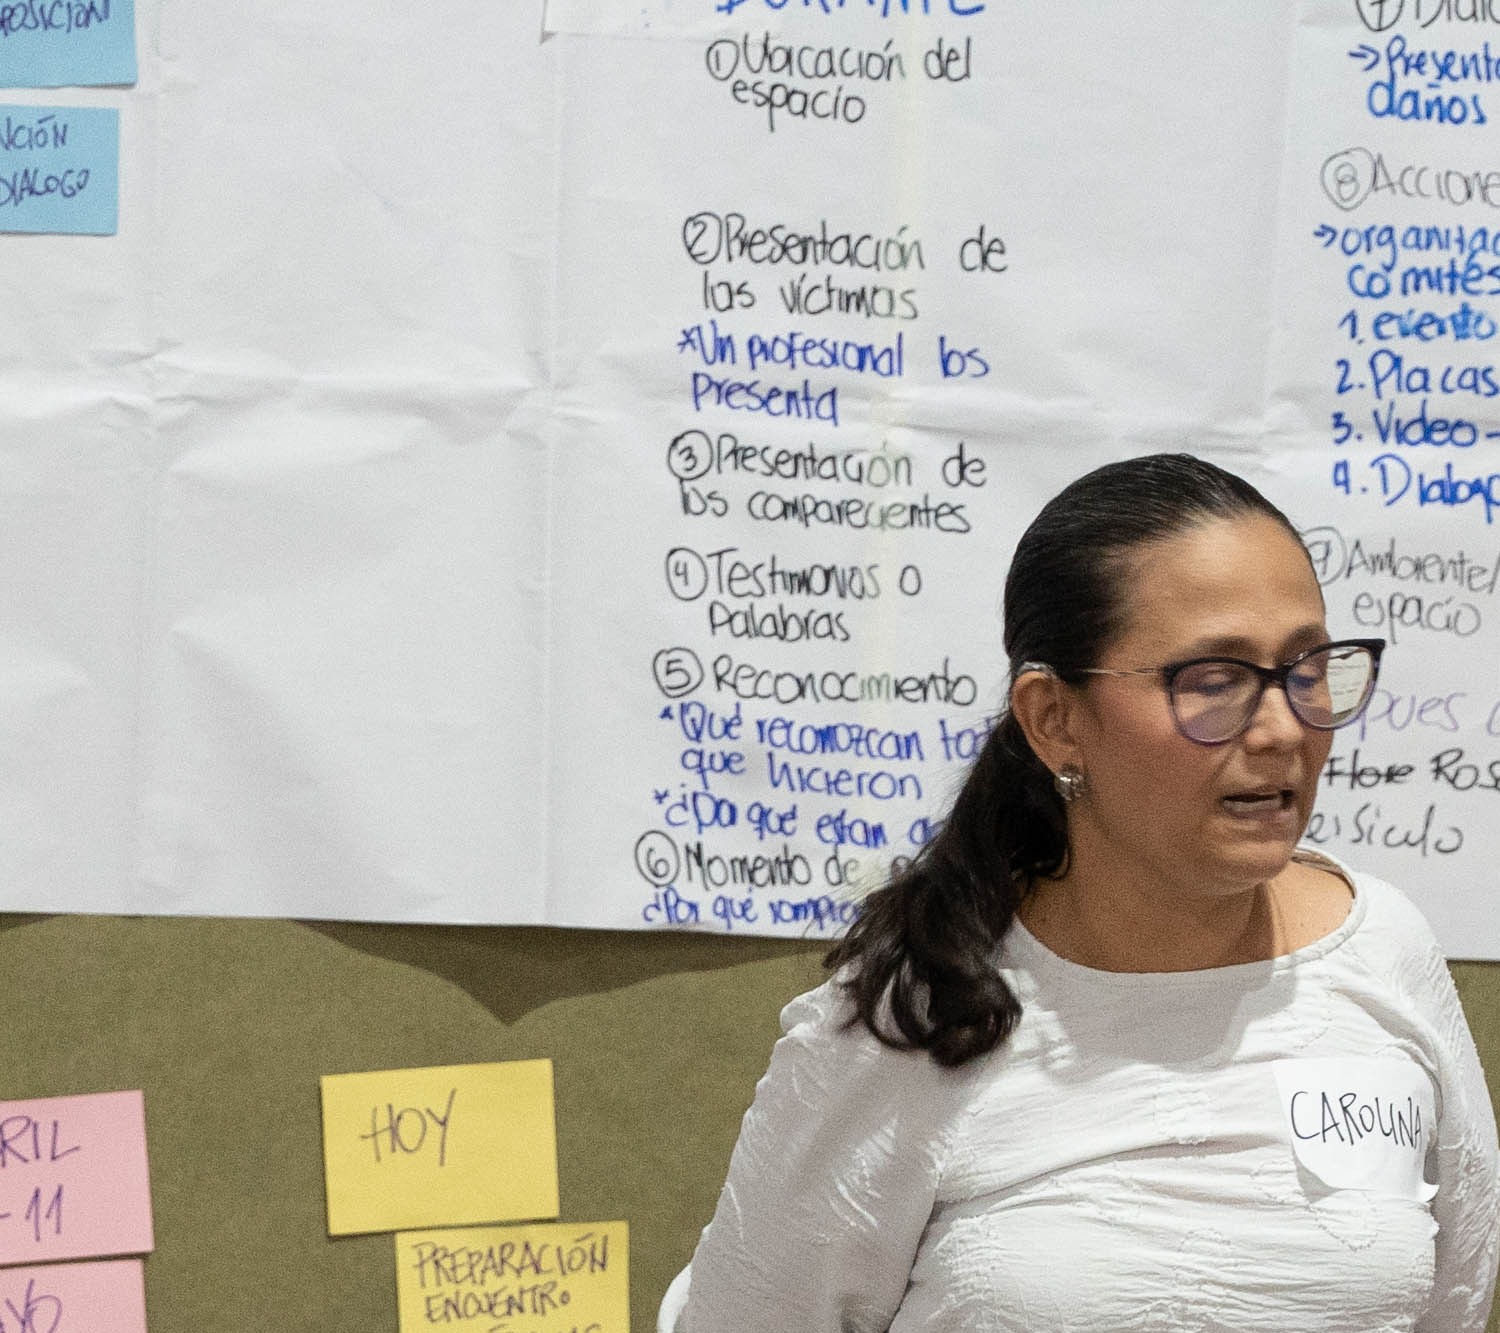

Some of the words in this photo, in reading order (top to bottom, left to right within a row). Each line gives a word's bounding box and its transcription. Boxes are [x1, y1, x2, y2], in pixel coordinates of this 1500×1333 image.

[923, 36, 972, 83] del
[730, 78, 867, 134] espacio
[1367, 78, 1489, 126] daños
[959, 224, 1008, 274] de
[938, 335, 991, 379] los
[1367, 353, 1500, 400] Placas
[941, 441, 986, 488] de
[898, 564, 923, 598] o
[1350, 592, 1481, 644] espacio
[712, 655, 978, 707] Reconocimiento
[680, 747, 747, 792] que
[765, 750, 924, 801] hicieron
[357, 1087, 459, 1168] HOY
[410, 1230, 611, 1290] PREPARACIÓN
